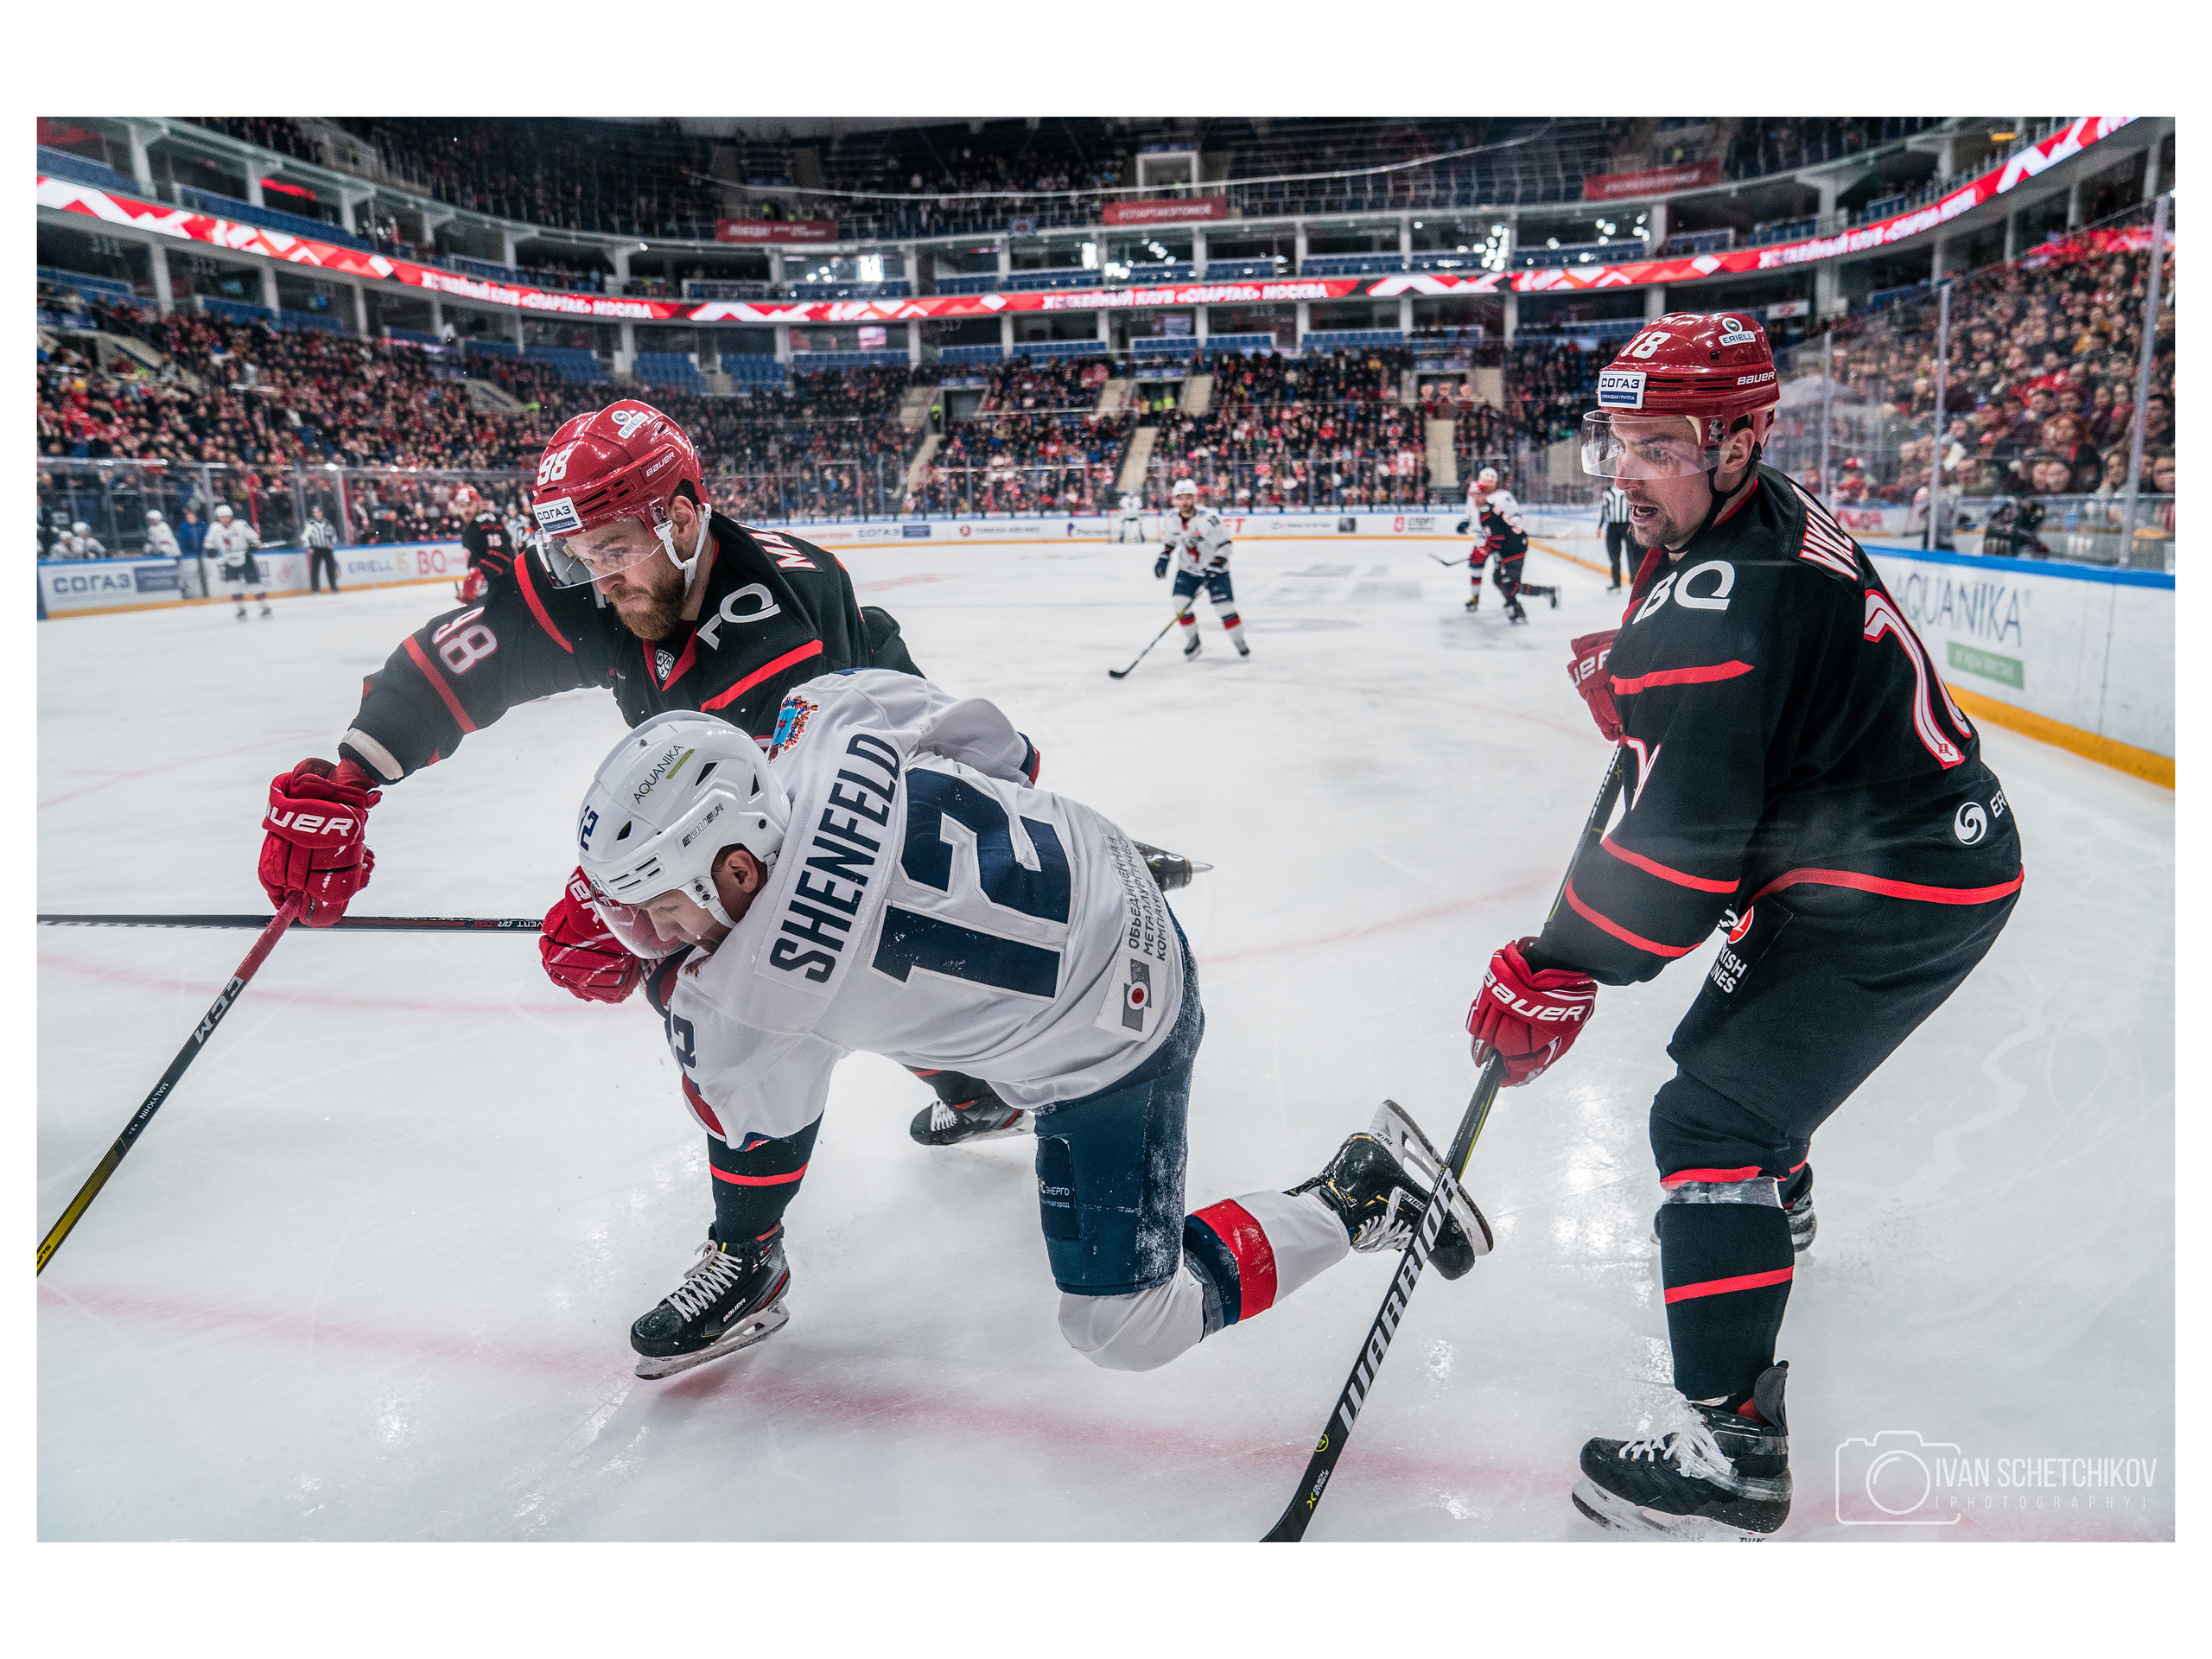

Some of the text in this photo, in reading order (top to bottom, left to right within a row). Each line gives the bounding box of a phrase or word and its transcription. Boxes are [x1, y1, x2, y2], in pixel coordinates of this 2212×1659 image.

[1135, 288, 1175, 305] КЛУБ
[1262, 282, 1328, 300] МОСКВА
[1620, 331, 1671, 359] 18
[1722, 334, 1754, 344] ERIELL
[1601, 378, 1640, 389] СОГАЗ
[1737, 372, 1775, 385] BAUER
[620, 415, 645, 436] ERIELL
[537, 449, 573, 486] 98
[645, 452, 676, 477] BAUER
[537, 505, 571, 520] СОГАЗ
[738, 524, 817, 569] MA
[857, 528, 900, 538] СОГАЗ
[417, 550, 446, 575] BQ
[53, 573, 131, 594] СОГАЗ
[1632, 560, 1735, 624] BQ
[633, 745, 684, 804] AQUANIKA
[267, 805, 355, 836] UER
[682, 803, 725, 849] BAUER
[769, 733, 900, 983] SHENFELD
[872, 766, 1072, 999] 12
[1483, 966, 1587, 1022] BAUER
[194, 975, 244, 1045] CCM
[138, 1082, 169, 1121] MALYKHIN
[723, 1297, 747, 1323] BAUER
[1338, 1166, 1459, 1434] WARRIOR
